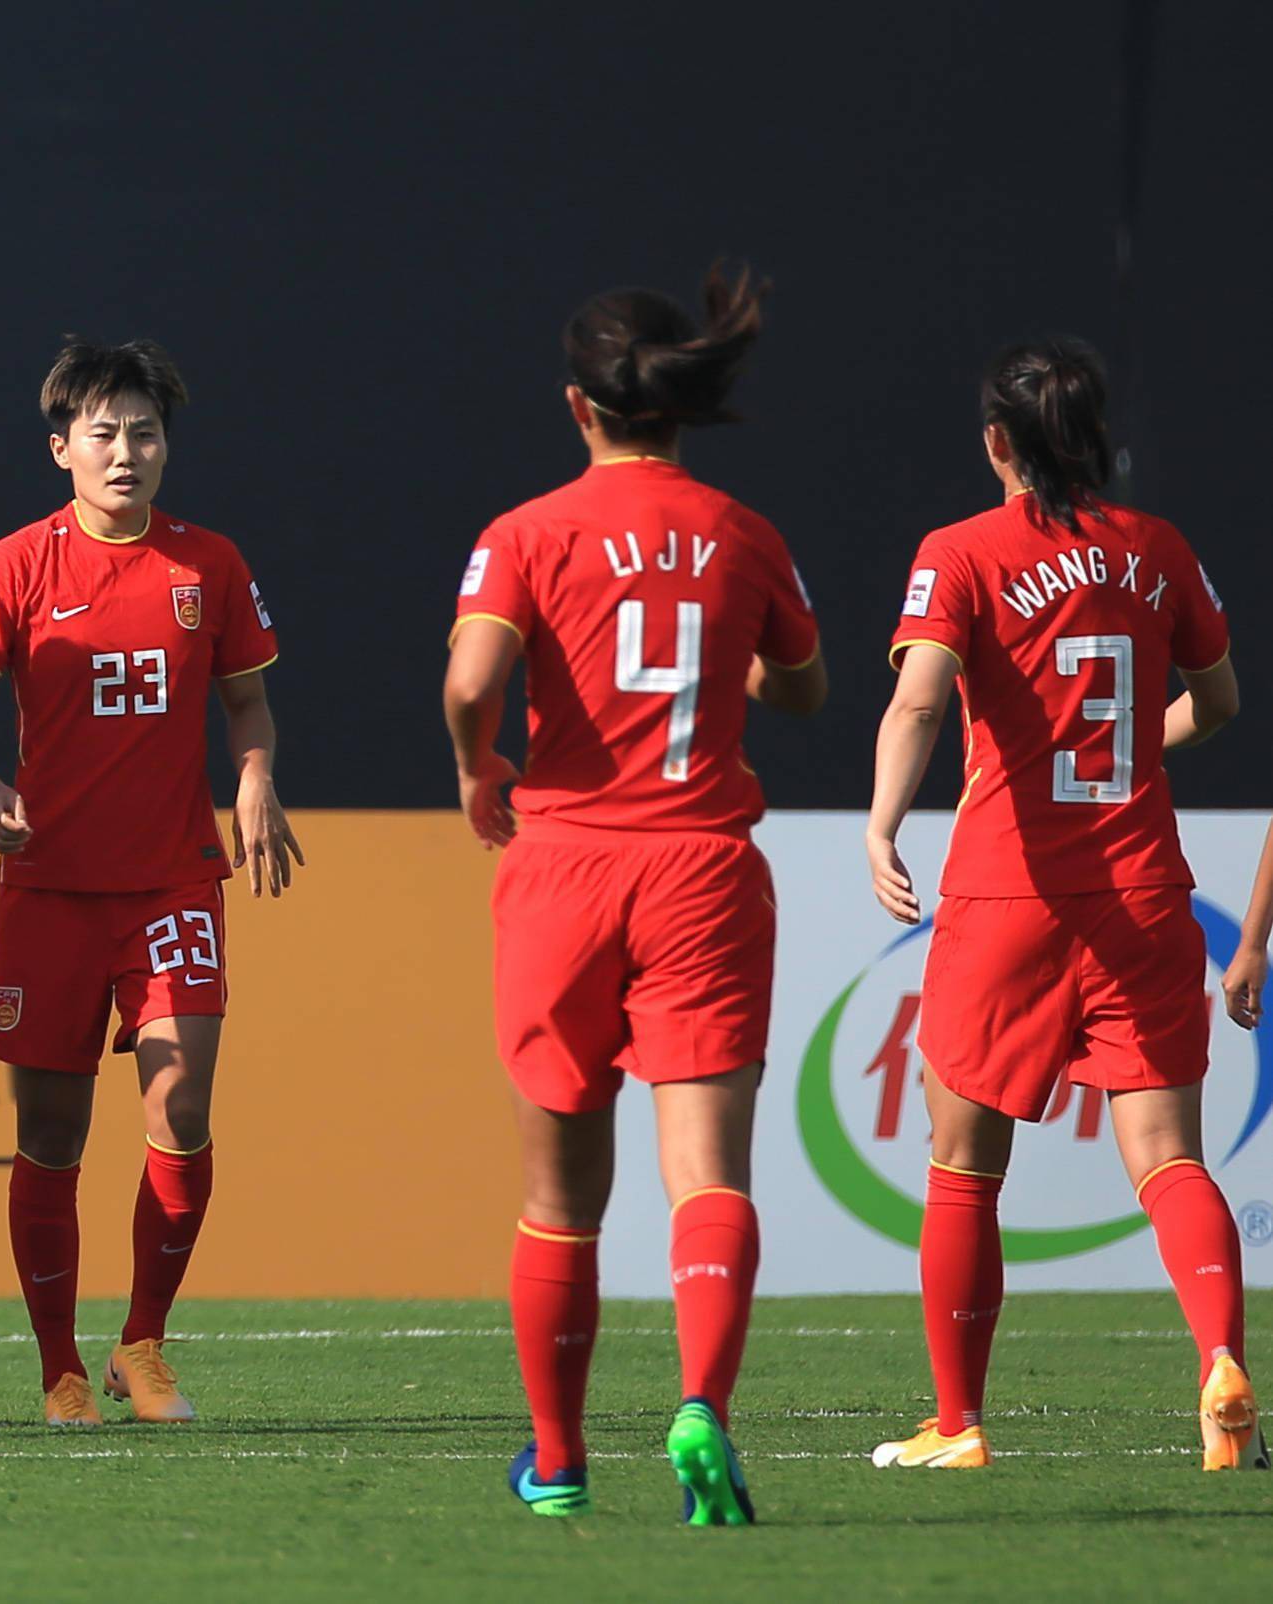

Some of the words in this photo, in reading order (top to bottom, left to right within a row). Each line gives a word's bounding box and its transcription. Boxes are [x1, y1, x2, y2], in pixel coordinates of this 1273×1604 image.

[603, 531, 644, 578] LI
[1000, 545, 1108, 620] WANG
[1120, 552, 1142, 593] X
[1145, 573, 1168, 611] X
[91, 648, 168, 717] 23
[615, 598, 703, 782] 4
[1052, 635, 1134, 804] 3
[146, 909, 220, 975] 23
